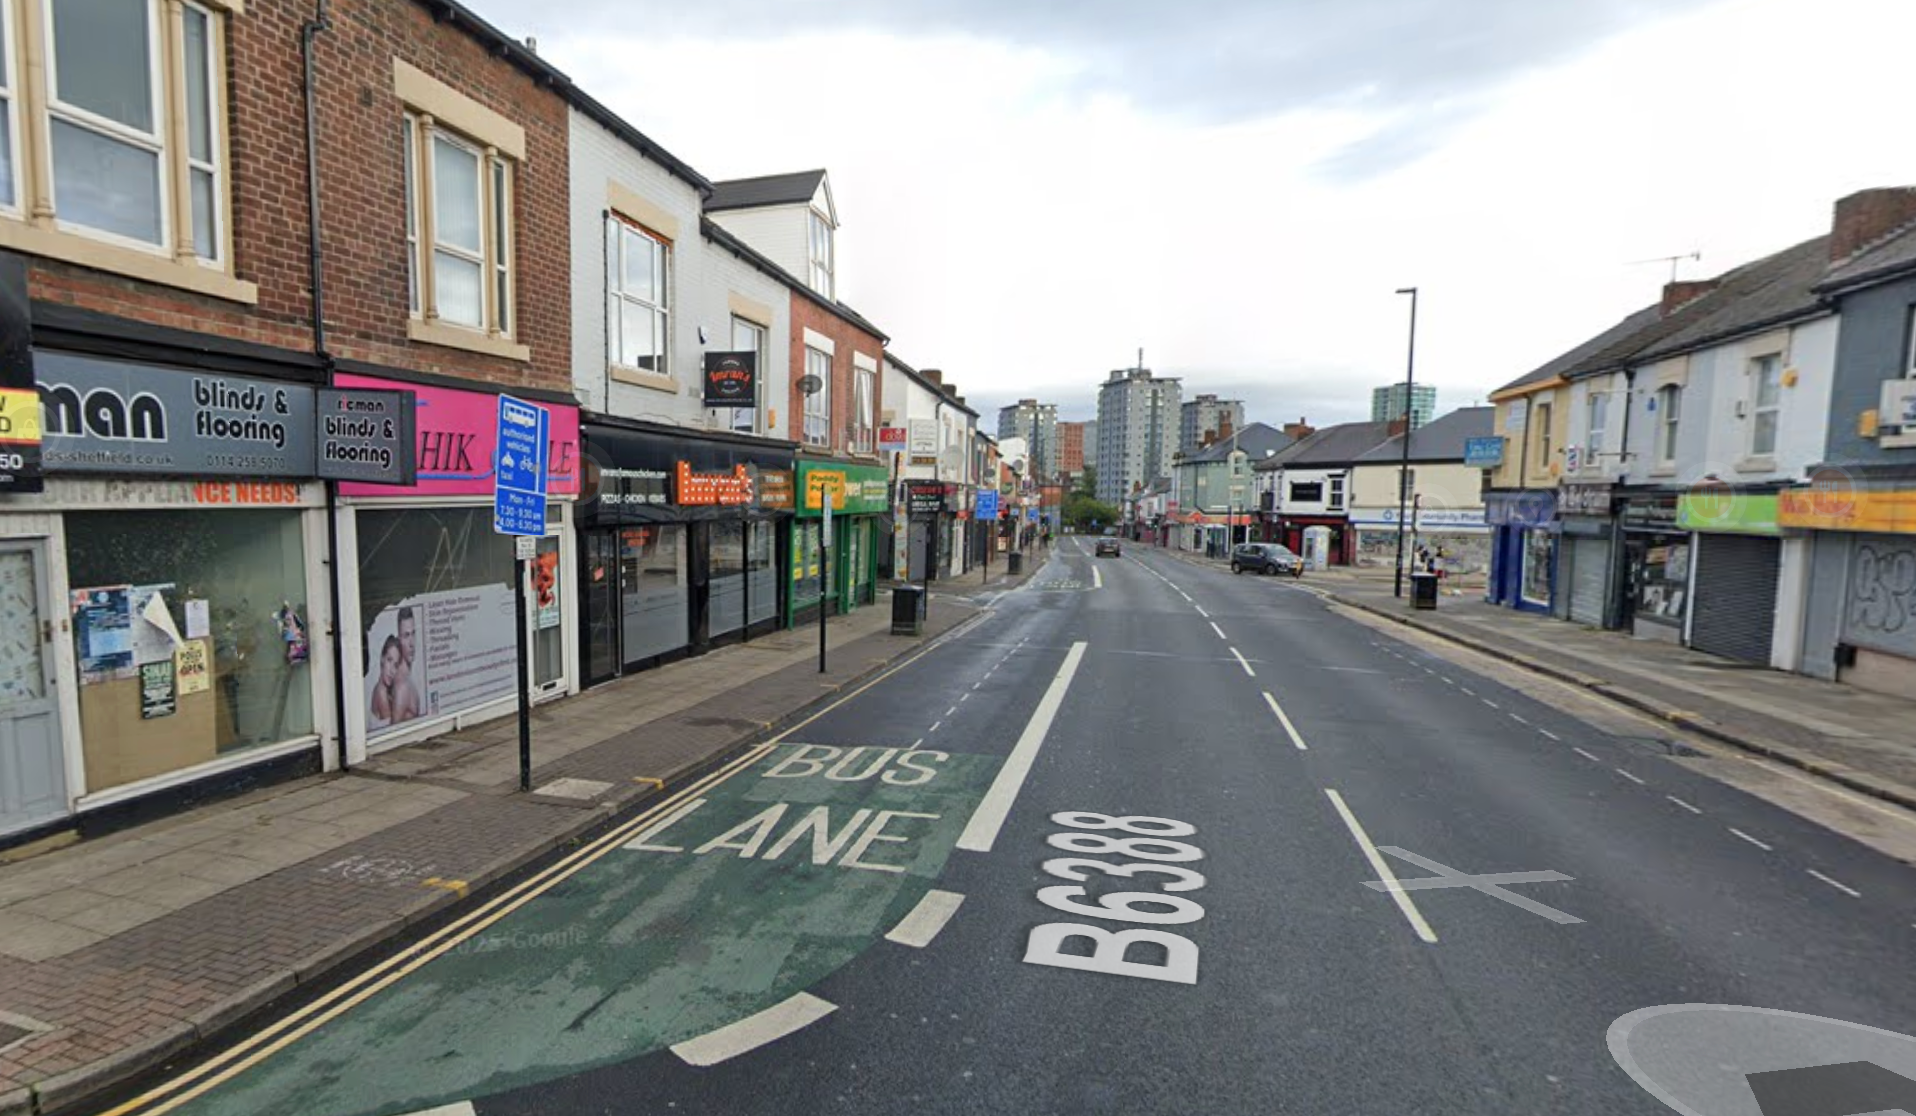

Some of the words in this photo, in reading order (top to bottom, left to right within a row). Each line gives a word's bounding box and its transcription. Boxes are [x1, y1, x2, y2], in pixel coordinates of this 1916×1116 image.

[192, 377, 266, 412] blinds
[274, 388, 290, 415] &
[337, 393, 385, 413] ricman
[195, 408, 286, 451] flooring
[324, 415, 377, 438] blinds
[383, 418, 396, 440] &
[502, 426, 535, 443] authorised
[324, 439, 392, 471] flooring
[506, 440, 531, 454] vehicles
[501, 469, 513, 481] taxi
[761, 743, 950, 787] BUS
[623, 799, 942, 873] LANE
[1022, 811, 1207, 985] B6388
